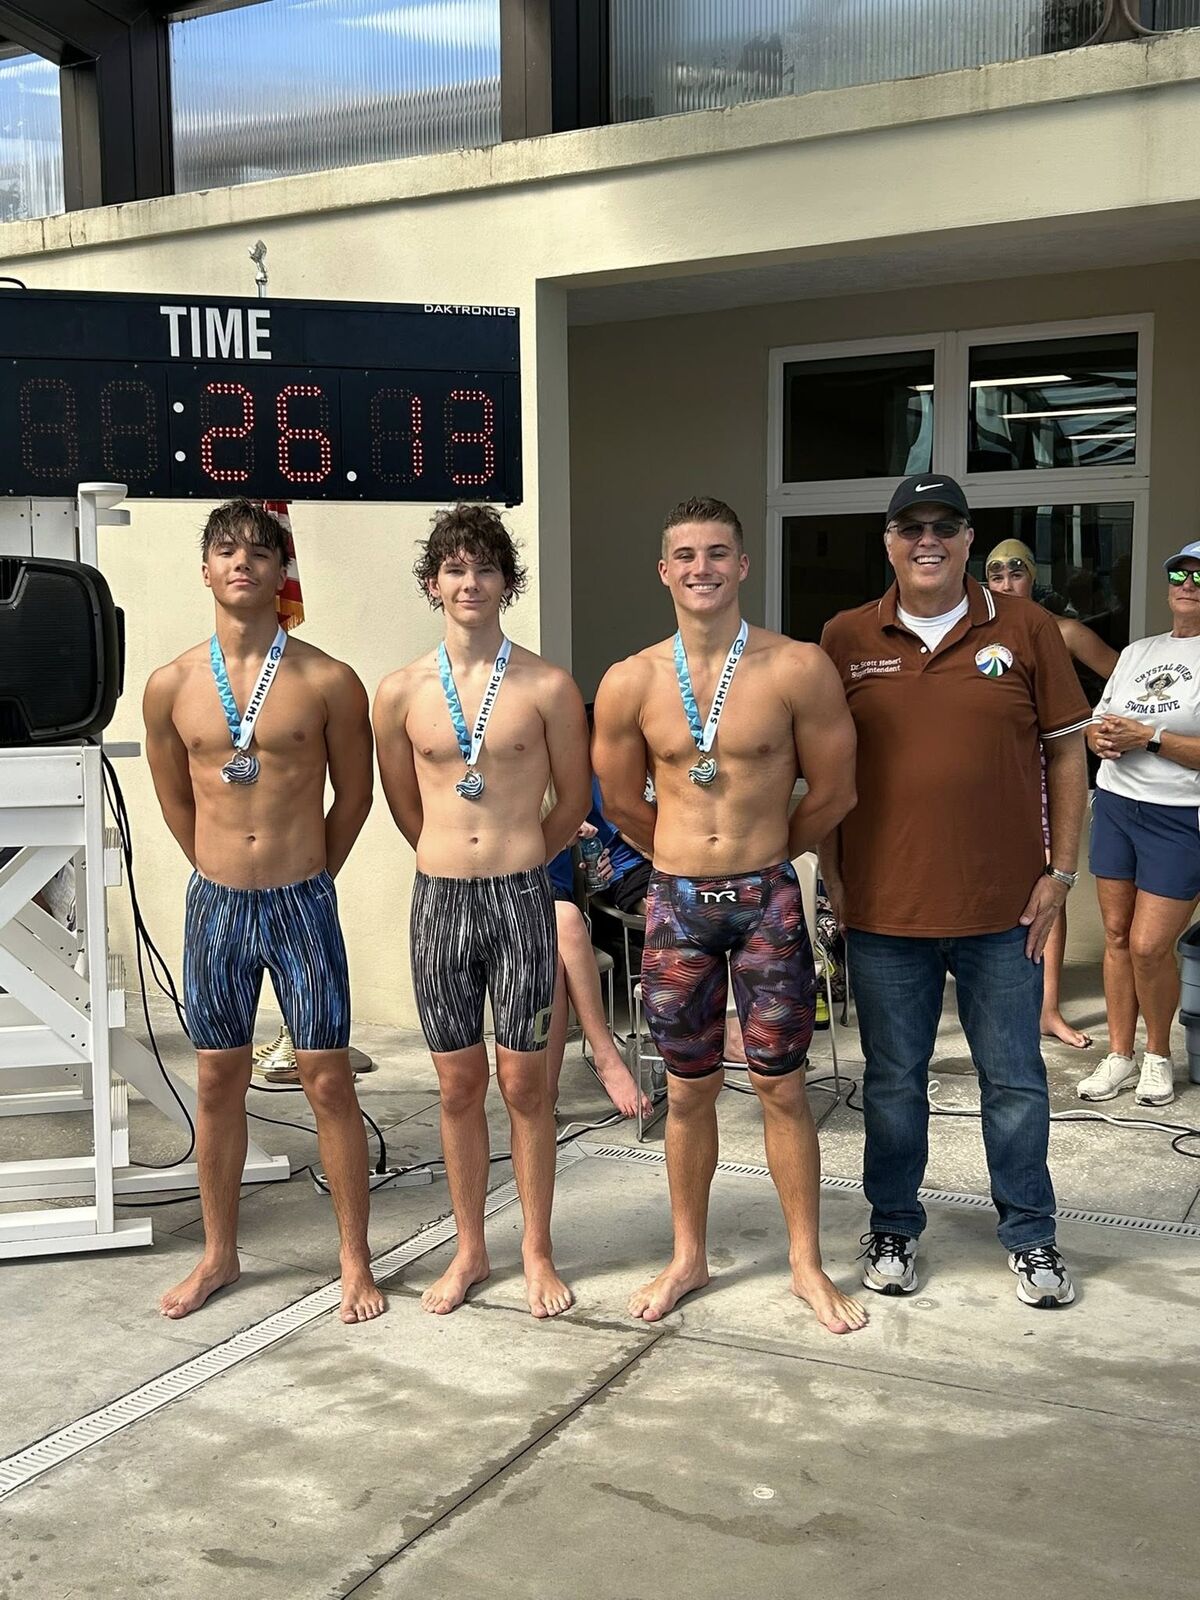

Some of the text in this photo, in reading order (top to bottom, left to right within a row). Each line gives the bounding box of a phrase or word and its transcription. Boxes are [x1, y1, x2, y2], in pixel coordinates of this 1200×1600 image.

[423, 303, 517, 317] DAKTRONICS
[159, 305, 273, 361] TIME
[245, 661, 276, 724] SWIMMING
[710, 655, 738, 725] SWIMMING
[1134, 663, 1193, 684] CRYSTAL RIVER
[474, 674, 502, 741] SWIMMING
[1125, 700, 1181, 714] SWIM & DIVE
[700, 891, 737, 904] TYR
